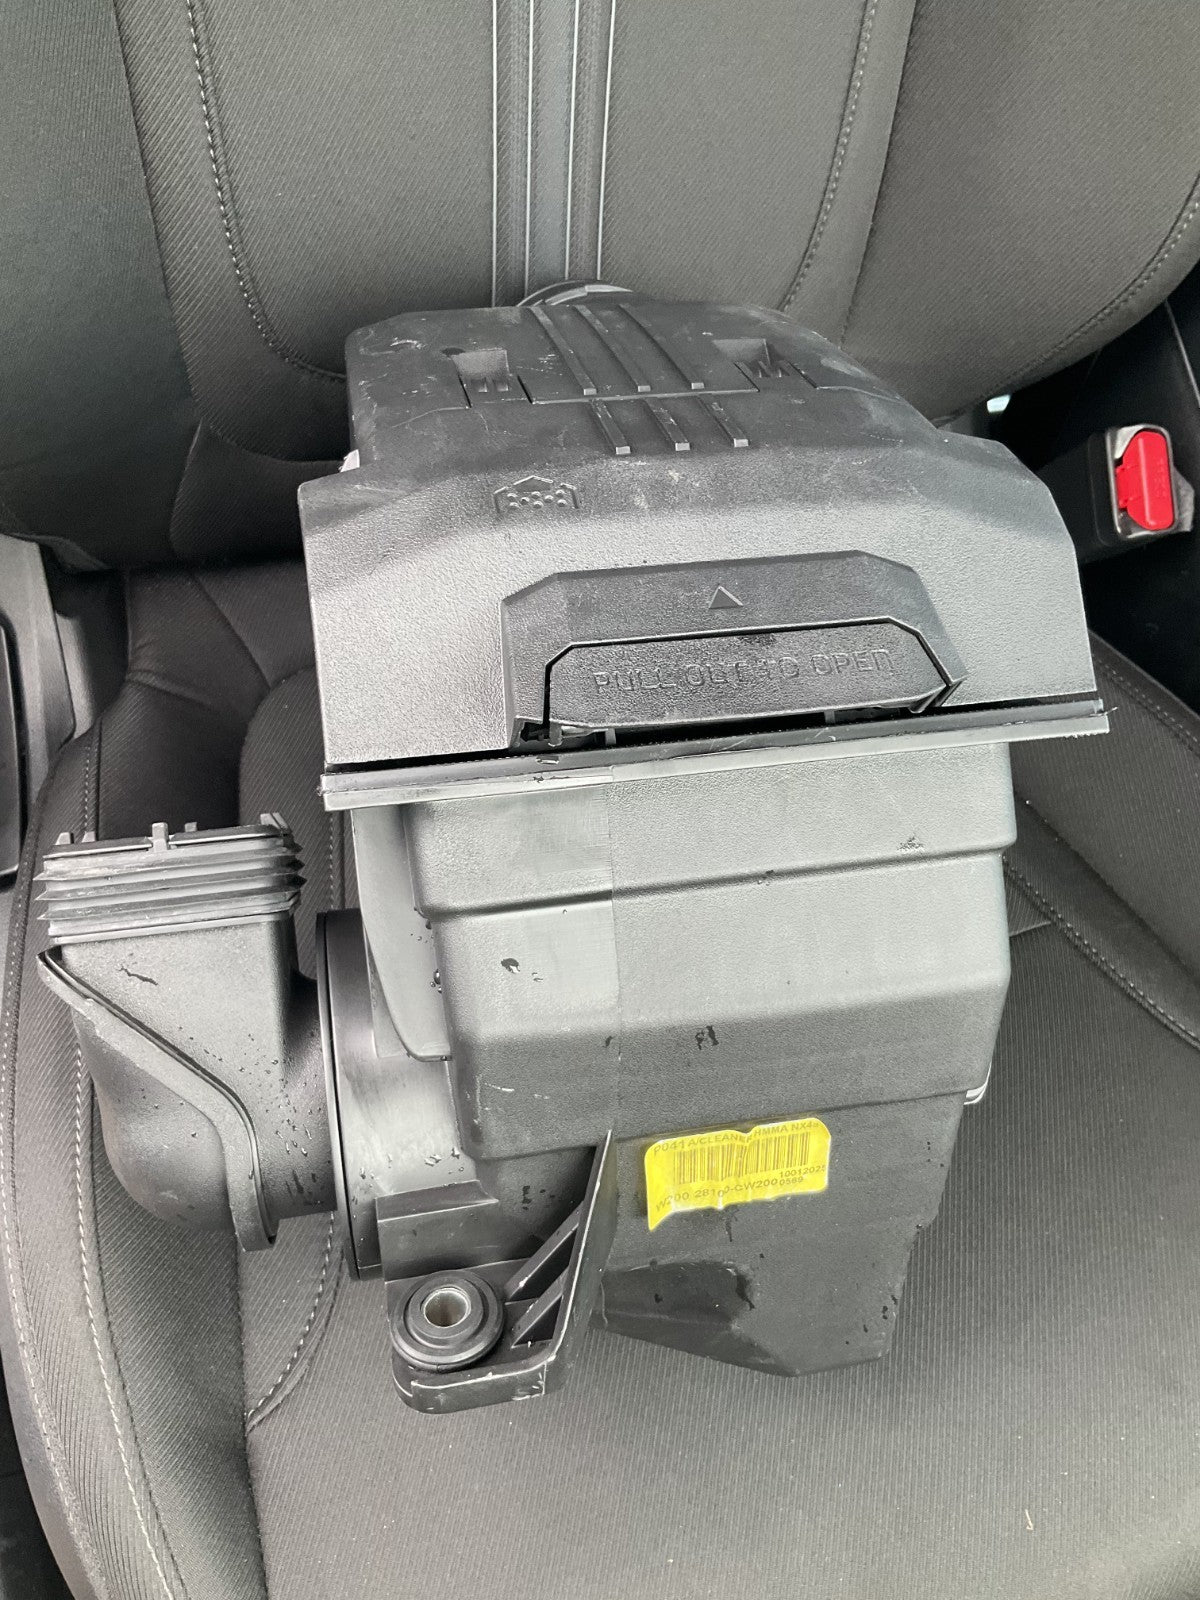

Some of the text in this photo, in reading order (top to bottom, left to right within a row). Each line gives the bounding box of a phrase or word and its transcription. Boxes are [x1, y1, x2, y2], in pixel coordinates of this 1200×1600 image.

[593, 649, 895, 694] PULL OUT TO OPEN
[755, 1125, 789, 1137] HMMA
[656, 1178, 778, 1211] W200 28100-CW200
